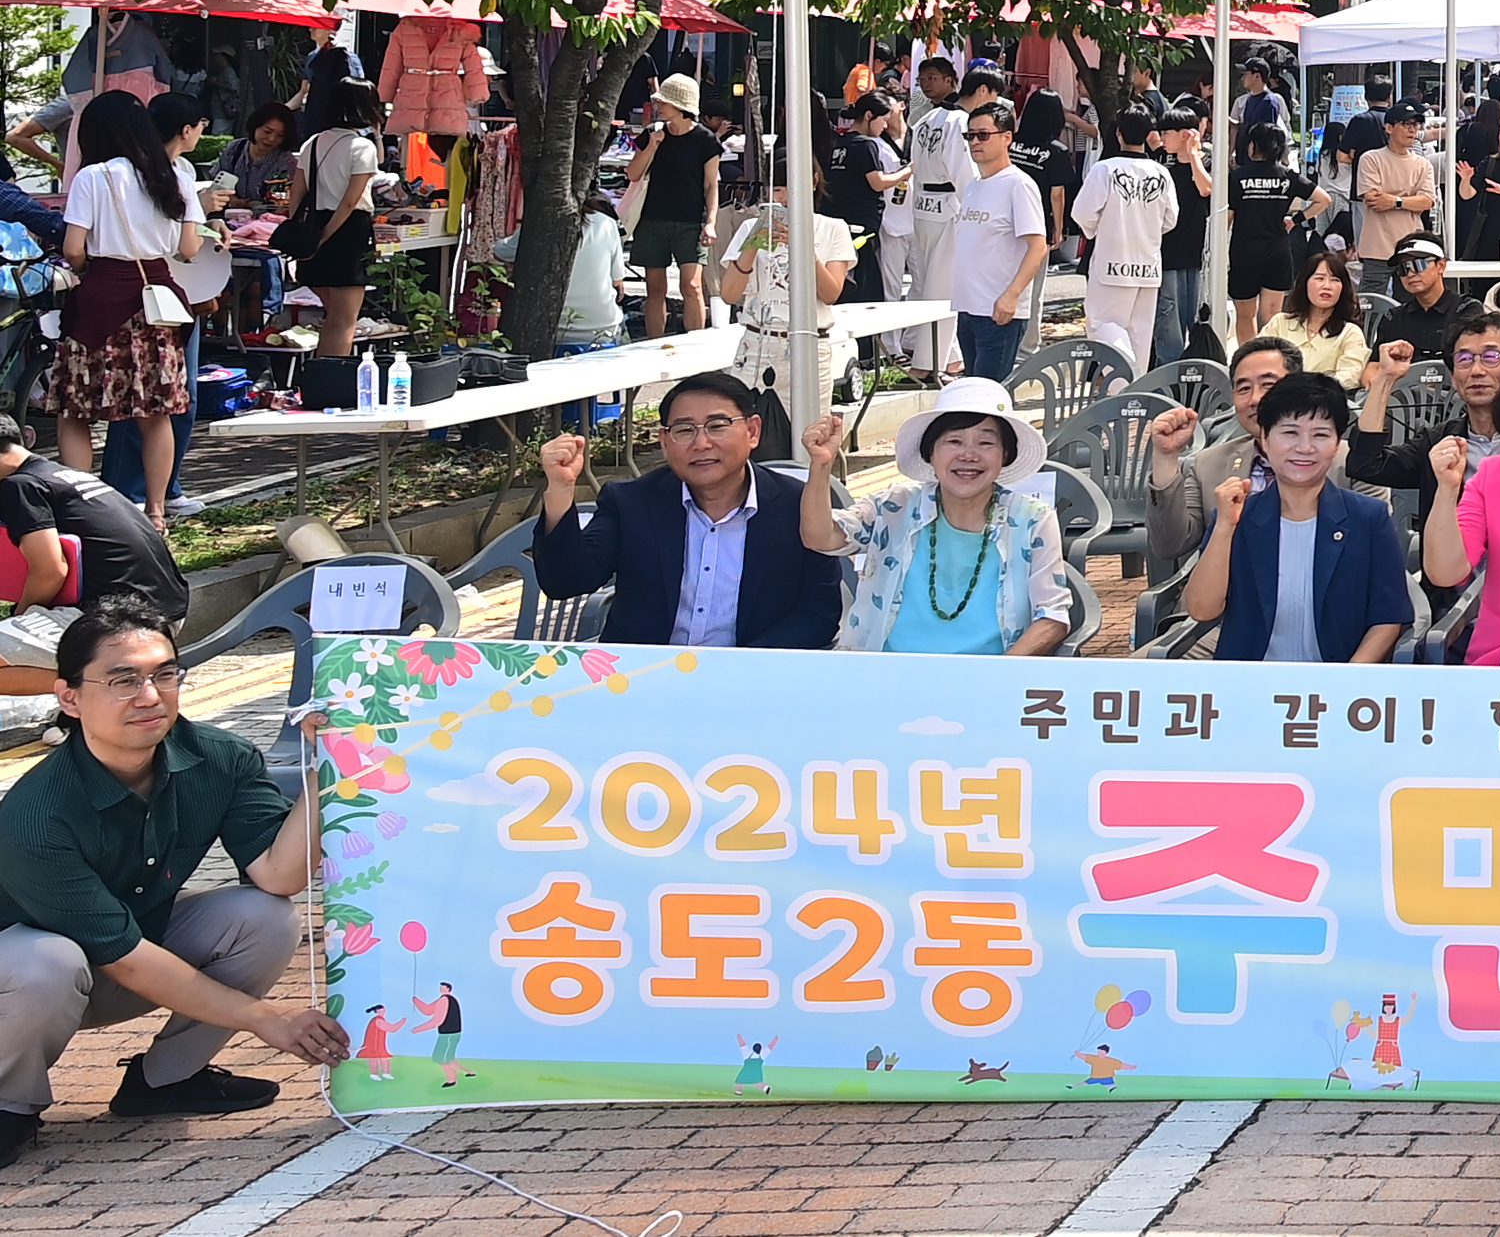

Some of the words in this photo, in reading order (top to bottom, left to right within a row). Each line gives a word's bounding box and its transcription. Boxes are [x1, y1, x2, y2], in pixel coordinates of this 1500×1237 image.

[1010, 142, 1041, 156] AEU
[1240, 178, 1281, 190] TAEMU
[914, 197, 943, 214] REA
[961, 206, 990, 224] Jeep
[1106, 262, 1160, 279] KOREA
[1020, 689, 1220, 744] 주민과
[1273, 693, 1436, 748] 같이!
[496, 757, 1026, 870] 2024년
[499, 881, 1035, 1028] 송도2동
